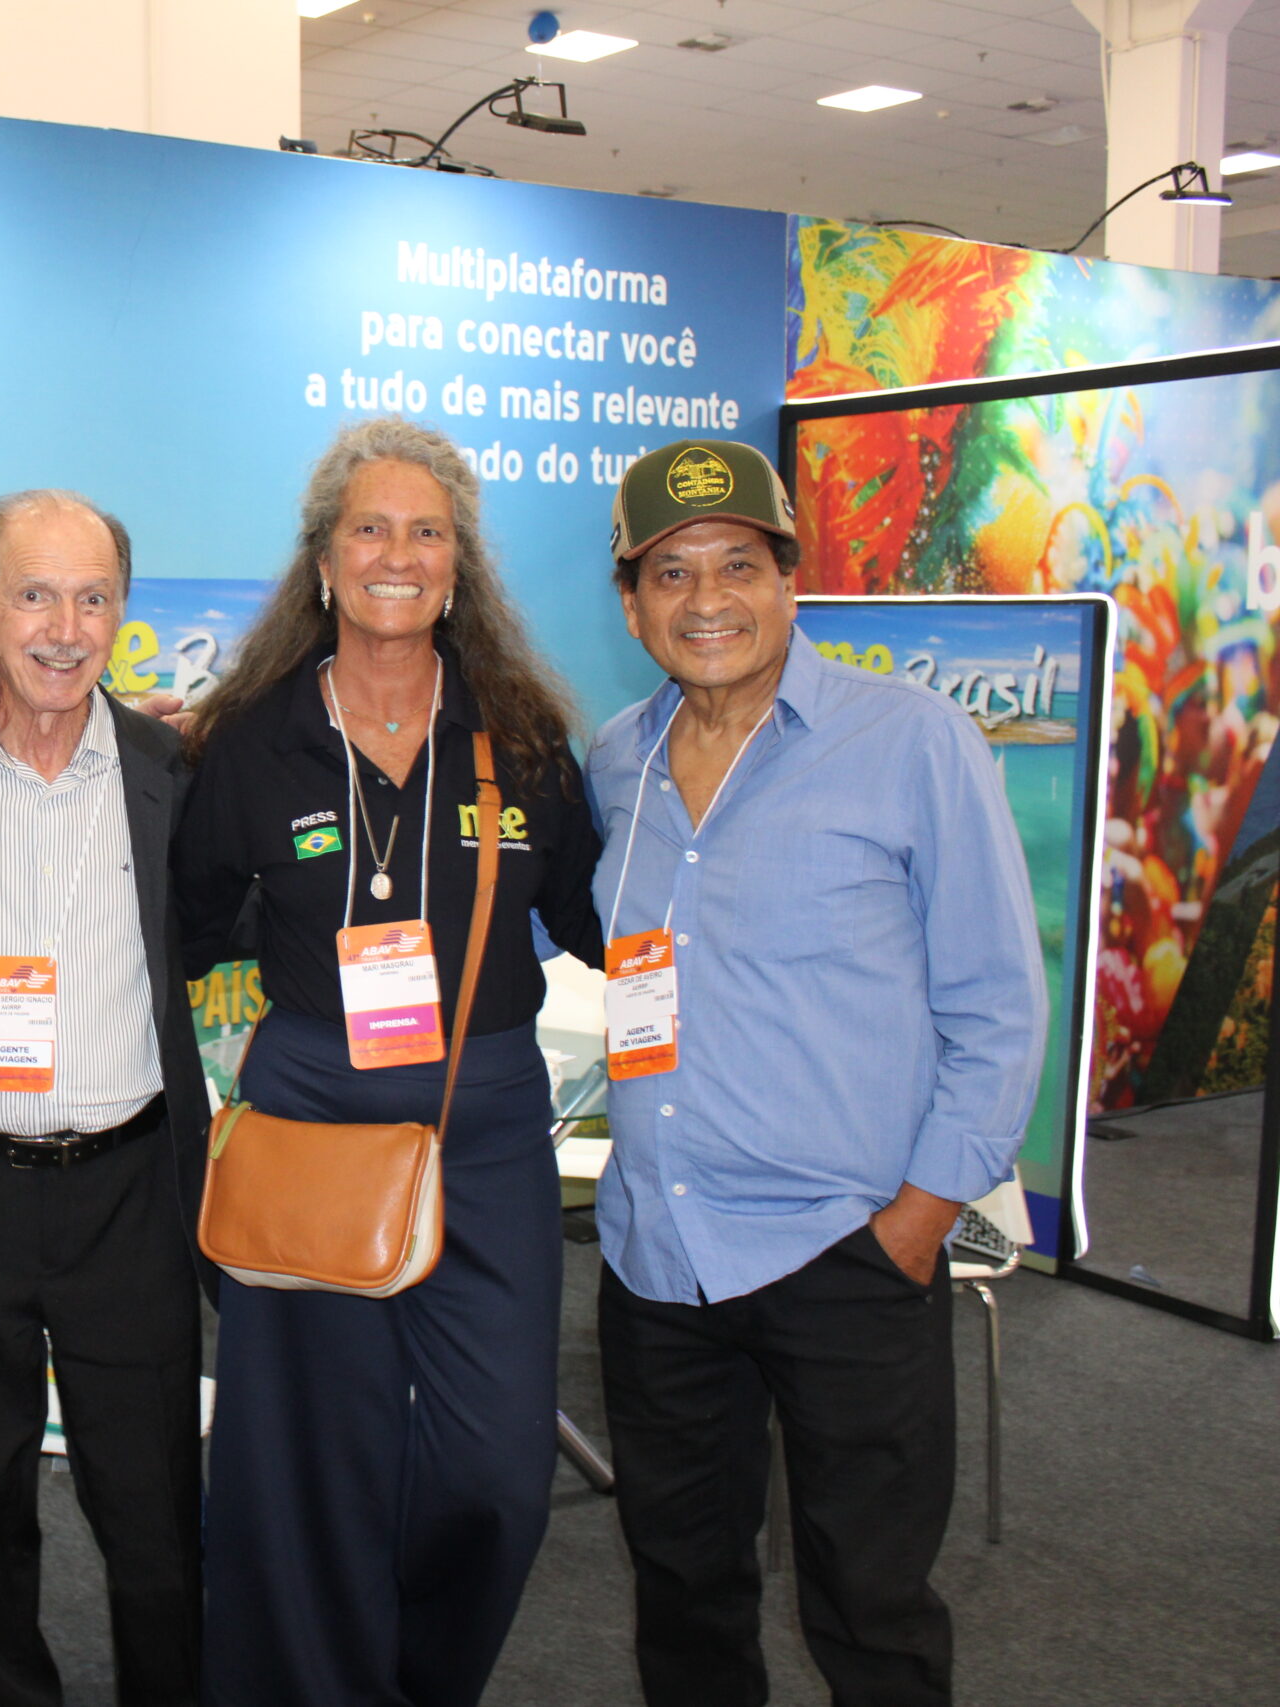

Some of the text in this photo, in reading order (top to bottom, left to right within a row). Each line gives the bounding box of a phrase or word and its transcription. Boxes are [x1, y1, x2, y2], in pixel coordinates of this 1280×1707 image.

[396, 240, 668, 305] Multiplataforma
[361, 309, 697, 367] para conectar você
[305, 369, 740, 430] a tudo de mais relevante
[536, 443, 579, 484] do
[590, 446, 647, 485] tur
[291, 810, 337, 831] PRESS
[361, 945, 392, 957] ABAV
[362, 964, 379, 972] MARI
[620, 956, 644, 969] ABAV
[0, 995, 25, 1003] SERGIO
[26, 996, 53, 1004] IGNACIO
[369, 1017, 418, 1030] IMPRENSA
[626, 1024, 656, 1036] AGENTE
[619, 1033, 662, 1048] DE VIAGENS
[0, 1055, 38, 1064] VIAGENS
